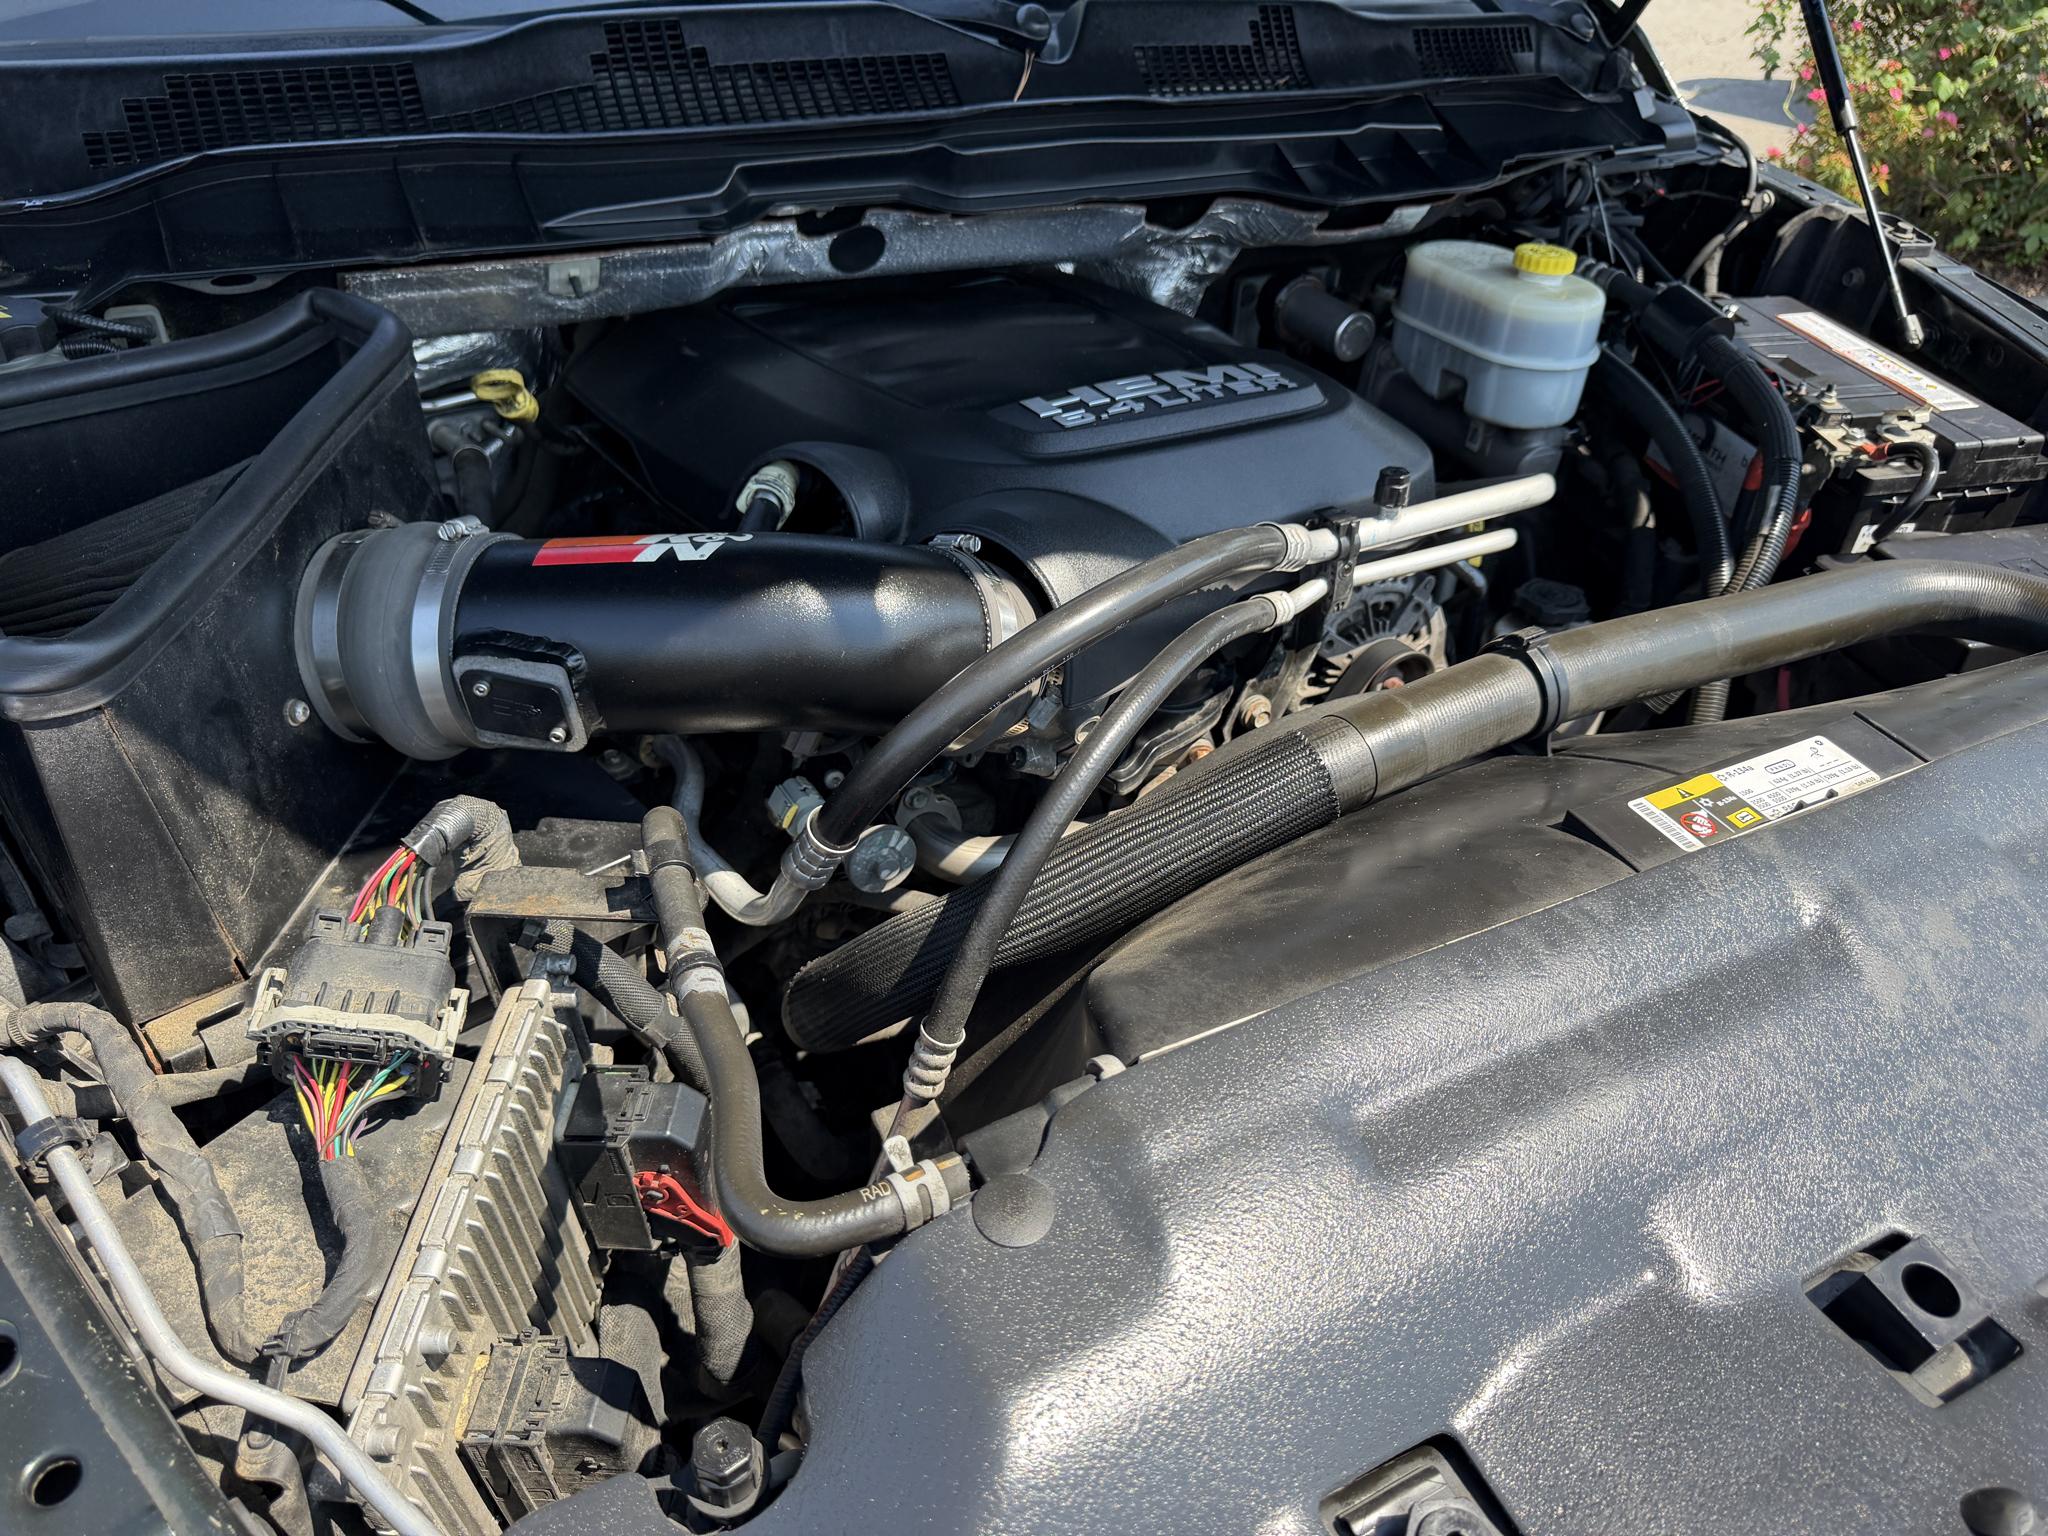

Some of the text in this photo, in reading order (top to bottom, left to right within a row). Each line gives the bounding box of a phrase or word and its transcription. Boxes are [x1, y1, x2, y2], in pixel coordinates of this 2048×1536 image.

[1020, 363, 1280, 418] HEMI
[1148, 377, 1298, 408] LITER
[1726, 765, 1755, 777] R-134a
[860, 1181, 892, 1203] RAD
